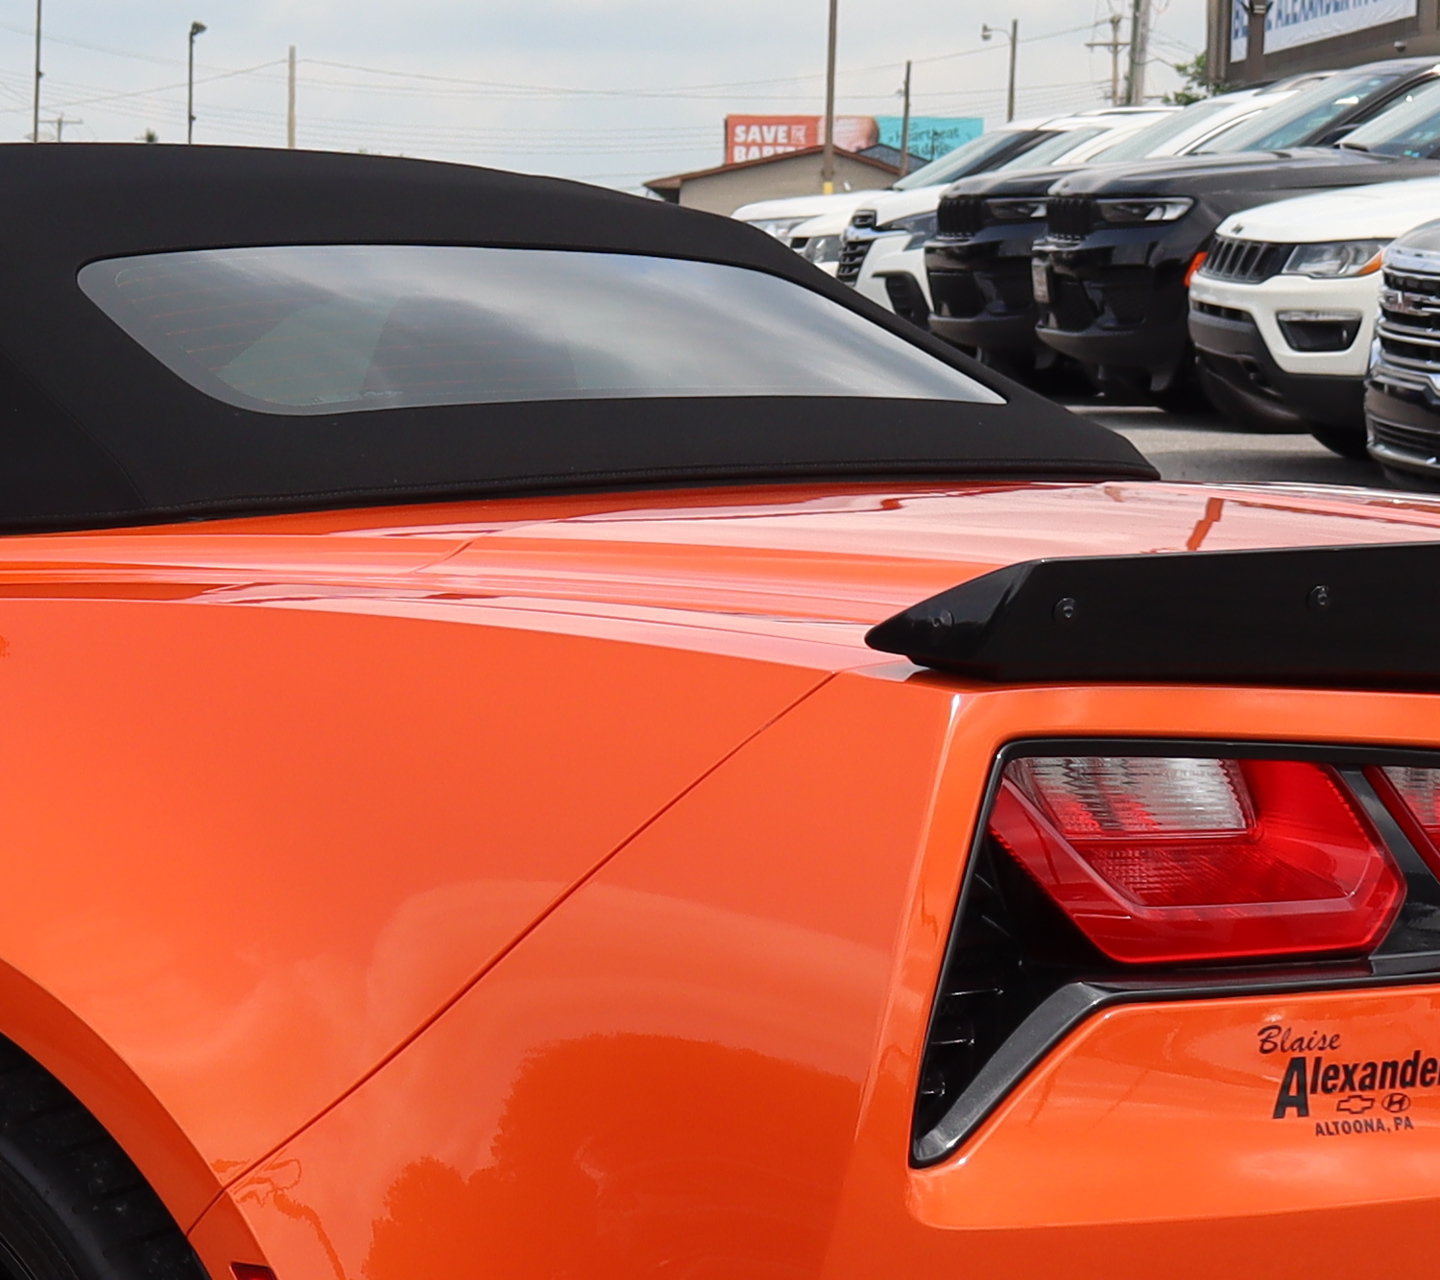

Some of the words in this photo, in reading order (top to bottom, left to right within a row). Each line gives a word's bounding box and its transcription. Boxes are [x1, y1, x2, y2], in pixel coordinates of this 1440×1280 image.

[734, 125, 789, 143] SAVE
[1257, 1025, 1341, 1054] Blaise
[1315, 1118, 1391, 1136] ALTOONA,
[1394, 1116, 1414, 1131] PA
